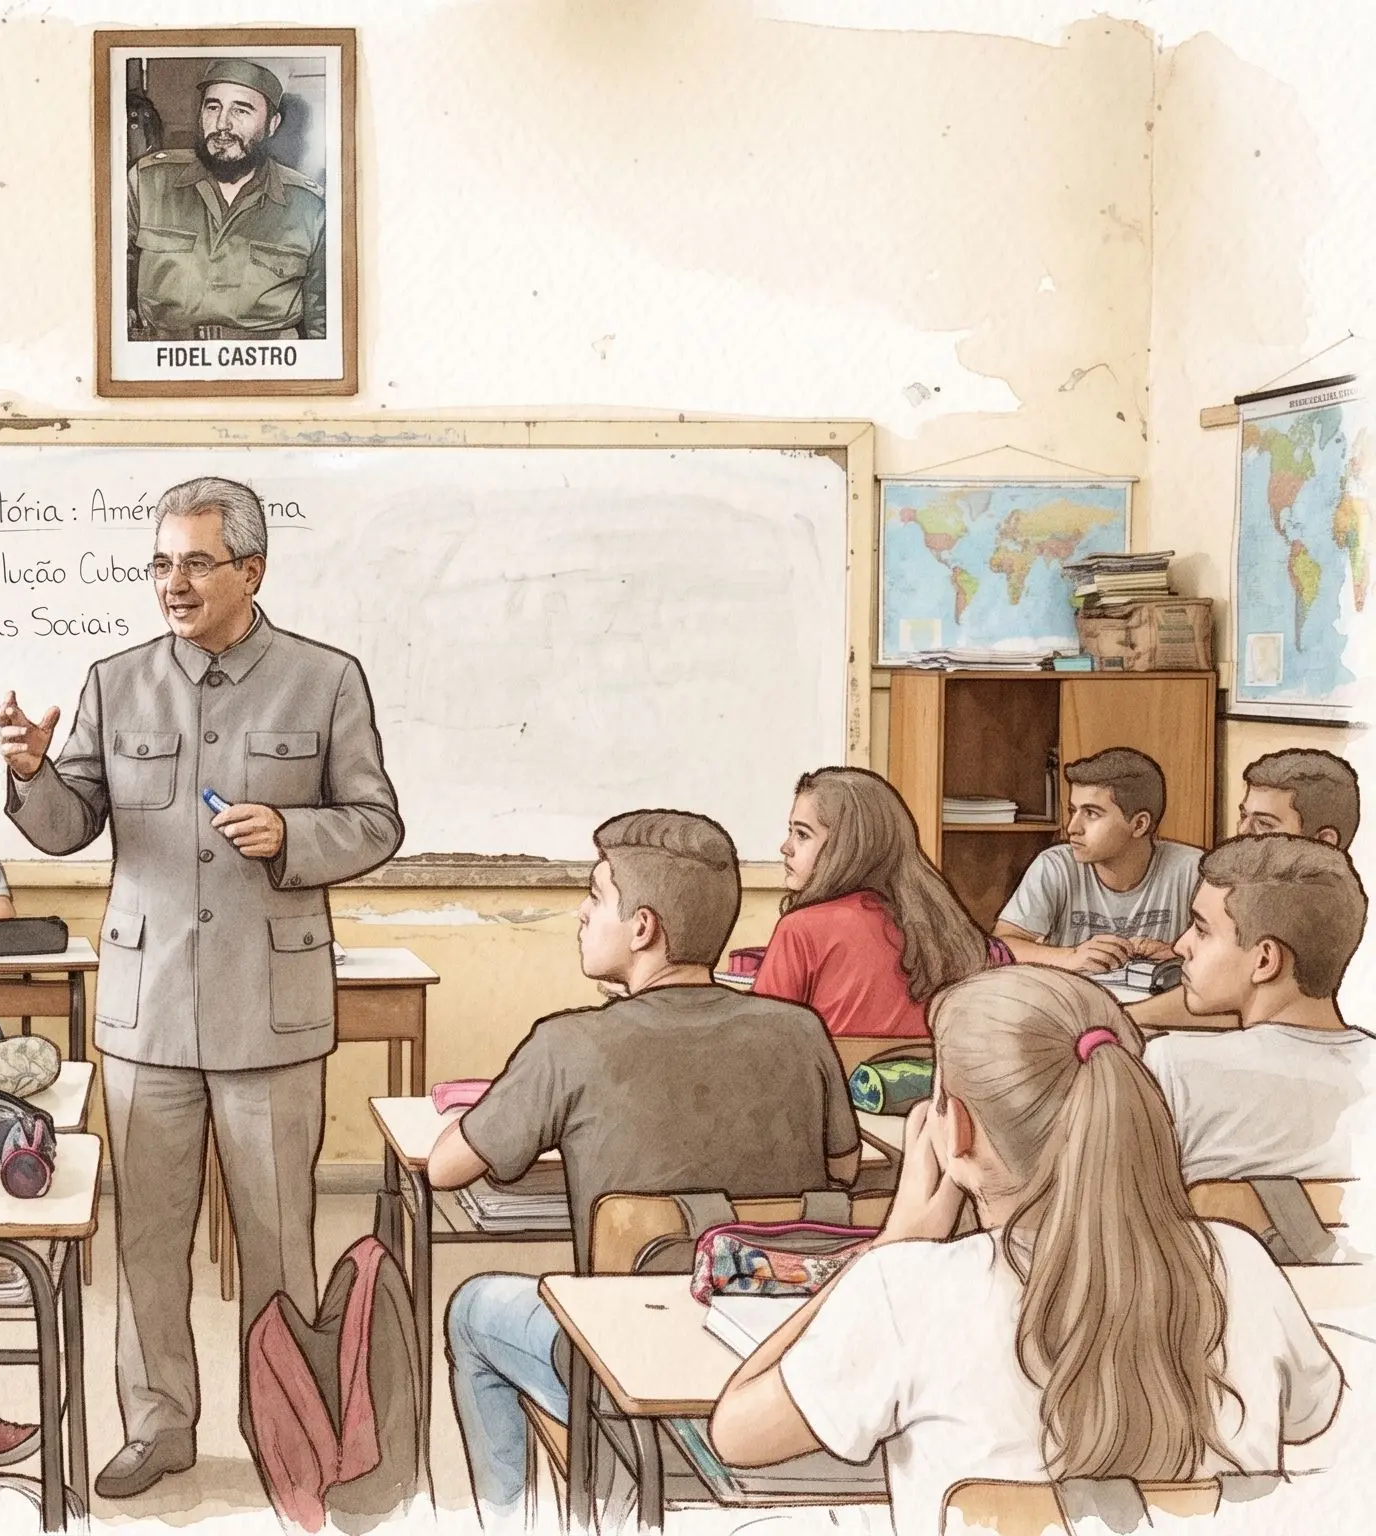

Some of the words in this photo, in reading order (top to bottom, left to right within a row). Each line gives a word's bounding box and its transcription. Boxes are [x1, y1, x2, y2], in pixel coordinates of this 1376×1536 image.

[156, 347, 212, 367] FIDEL
[218, 346, 297, 366] CASTRO
[91, 488, 156, 523] Amér
[80, 551, 149, 584] Cuba
[31, 606, 129, 637] Sociais
